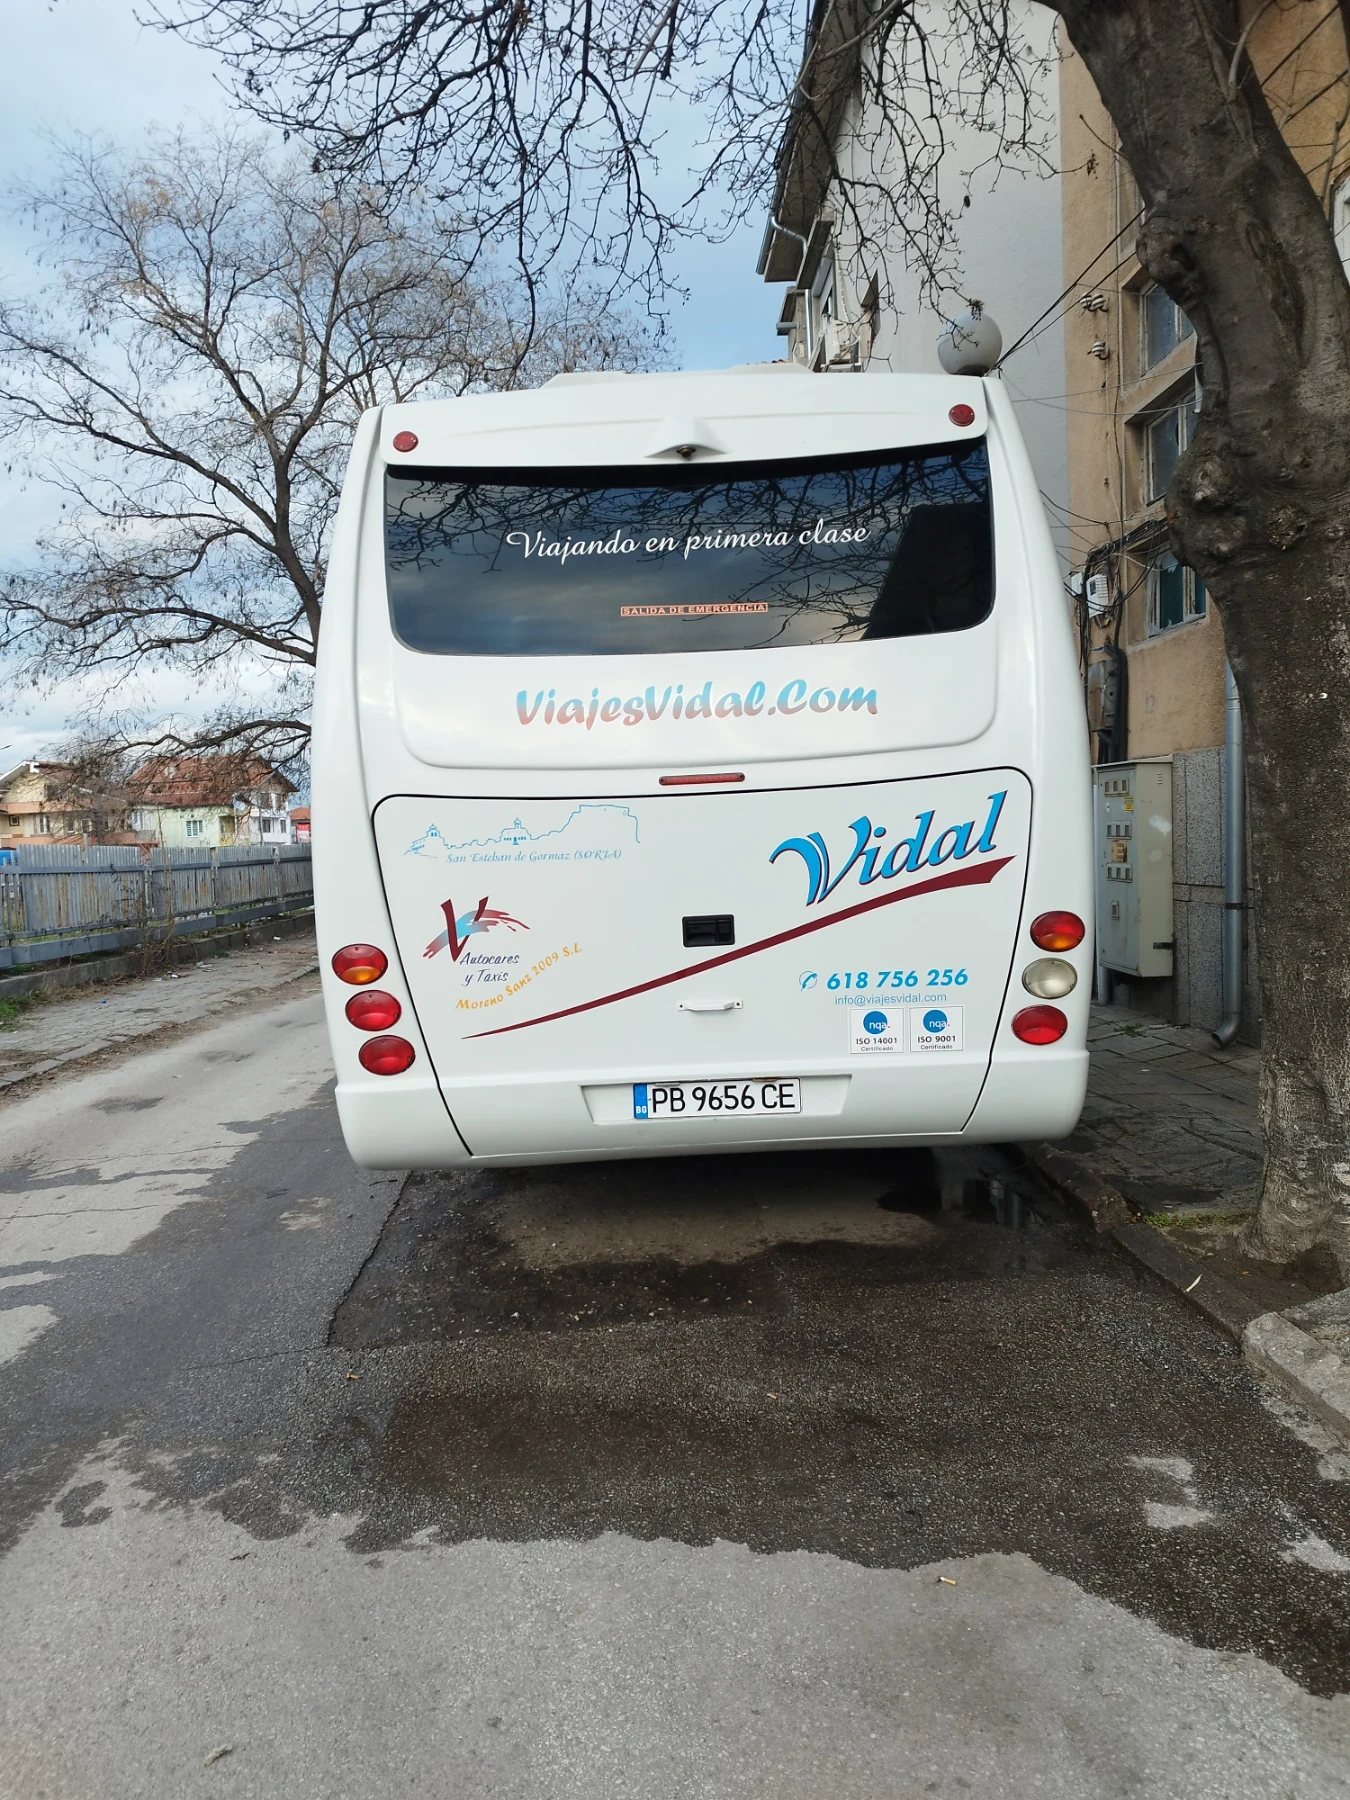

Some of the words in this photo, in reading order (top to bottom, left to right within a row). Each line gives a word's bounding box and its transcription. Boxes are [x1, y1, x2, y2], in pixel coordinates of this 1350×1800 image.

[506, 530, 638, 566] Viajando
[645, 536, 680, 552] en
[684, 525, 793, 560] primera
[798, 517, 872, 544] clase
[623, 606, 666, 615] SALIDA
[669, 605, 685, 614] DE
[688, 604, 766, 613] EMERGENCIA
[515, 678, 878, 731] ViajesVidal.Com
[769, 789, 1008, 907] Vidal
[446, 853, 466, 863] San
[470, 851, 511, 862] Esteban
[514, 851, 526, 861] de
[529, 851, 570, 862] Gormaz
[459, 951, 520, 966] Autocares
[455, 994, 504, 1010] Moreno
[505, 974, 532, 996] Sanz
[532, 952, 559, 976] 2009
[461, 974, 474, 987] y
[477, 968, 509, 982] Taxis
[826, 972, 869, 990] 618
[876, 971, 919, 988] 756
[926, 968, 969, 987] 256
[834, 992, 947, 1006] info@viajesvidal.com
[856, 1037, 871, 1045] ISO
[873, 1037, 898, 1045] 14001
[935, 1035, 956, 1043] 9001
[652, 1086, 686, 1113] PB
[692, 1084, 756, 1112] 9656
[761, 1083, 796, 1109] CE
[635, 1105, 647, 1114] BG
